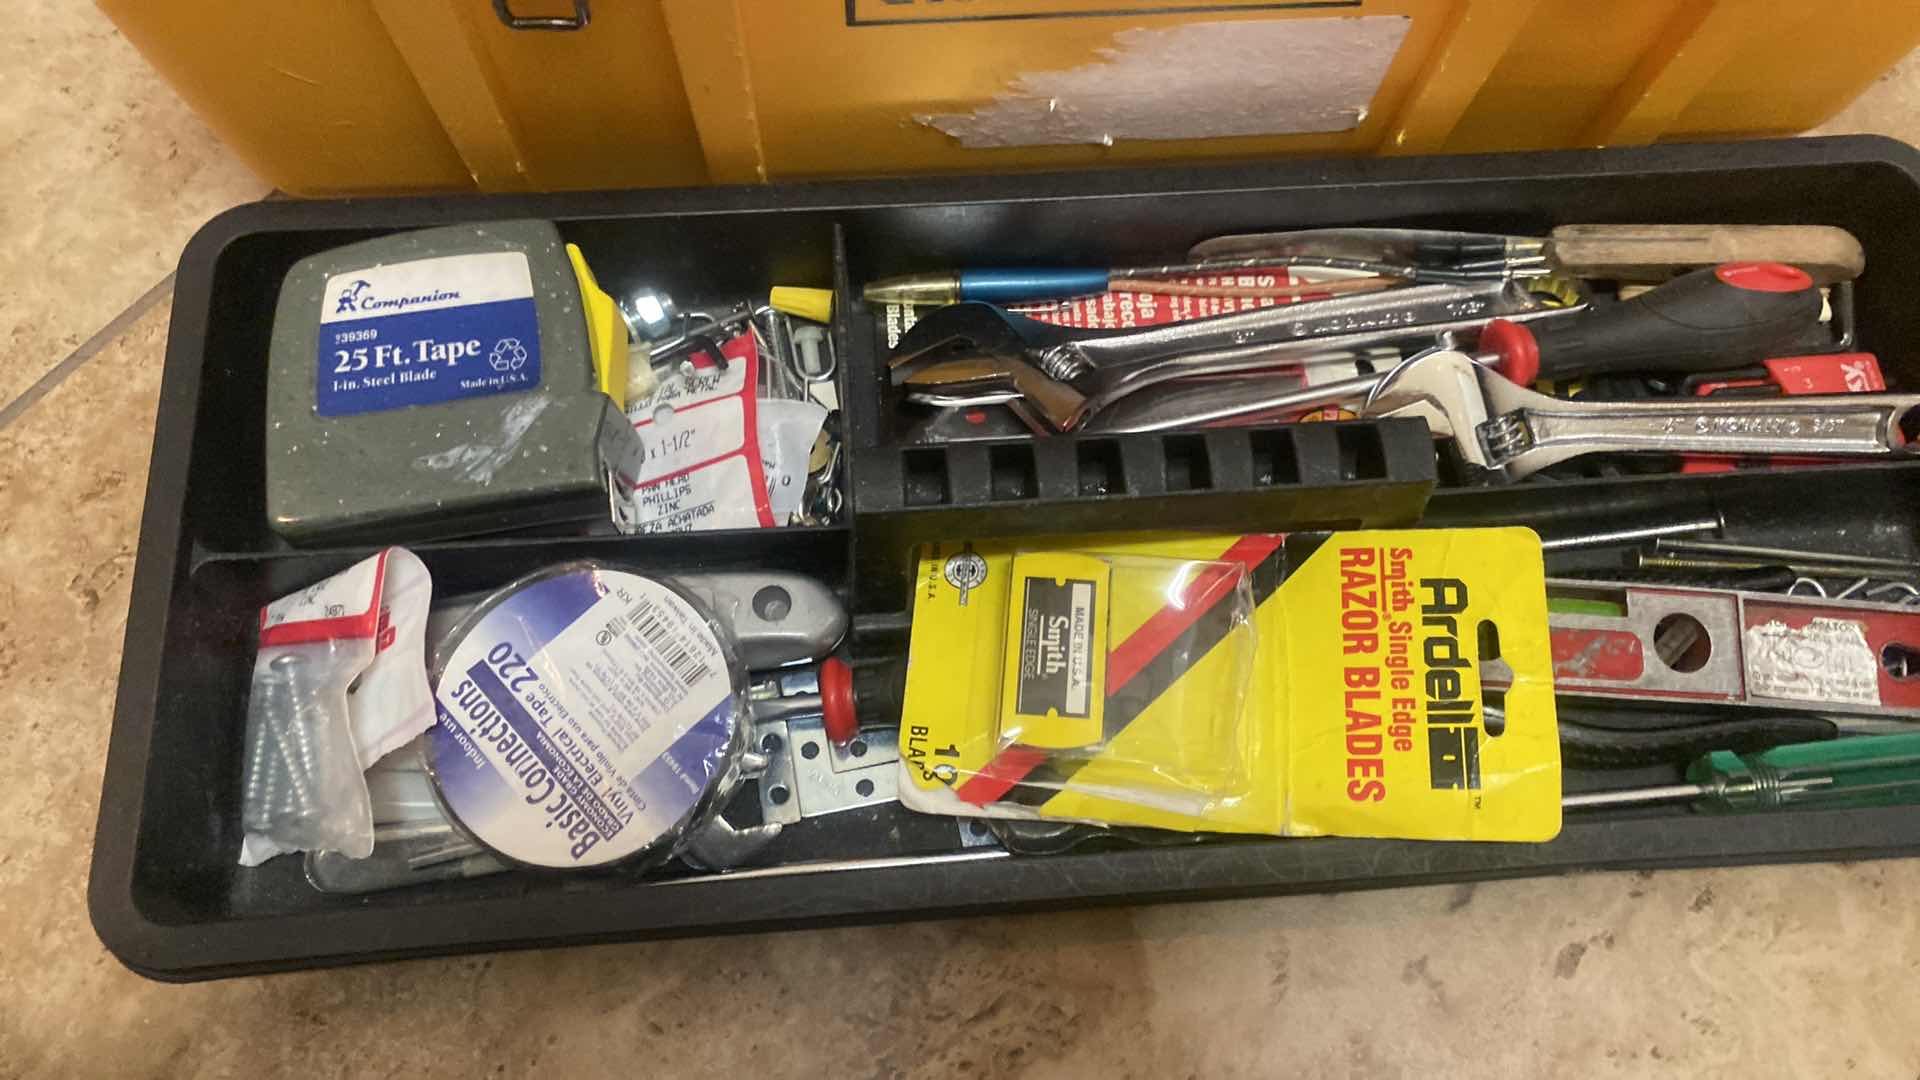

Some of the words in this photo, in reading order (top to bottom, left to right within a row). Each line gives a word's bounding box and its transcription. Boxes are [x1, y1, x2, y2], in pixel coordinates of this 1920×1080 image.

[360, 289, 460, 310] Companion
[886, 304, 901, 349] Blades
[334, 347, 369, 374] 25
[374, 343, 410, 368] Ft.
[412, 338, 481, 367] Tape
[333, 379, 360, 392] 1-in.
[363, 372, 395, 388] Steel
[400, 367, 437, 384] Blade
[460, 377, 487, 390] Made
[489, 376, 499, 386] in
[661, 427, 696, 456] 1-1/2"
[642, 484, 692, 508] PHILLIPS
[657, 500, 682, 516] ZINC
[615, 586, 633, 605] KR
[1389, 547, 1415, 612] Smith
[1339, 546, 1375, 656] RAZOR
[1025, 608, 1039, 647] SINGLE
[1073, 607, 1084, 639] MADE
[1044, 615, 1069, 675] Smith
[1072, 643, 1083, 653] IN
[1384, 622, 1415, 690] Single
[1419, 577, 1475, 725] Ardell
[483, 637, 540, 696] 220
[1023, 649, 1036, 681] EDGE
[1071, 656, 1083, 690] U.S.A.
[436, 712, 457, 734] use
[521, 689, 552, 728] Tape
[1387, 698, 1416, 752] Edge
[450, 677, 560, 809] Connections
[454, 728, 487, 770] Indoor
[579, 730, 599, 752] para
[1343, 666, 1386, 802] BLADES
[533, 730, 575, 776] ECONOMIA
[551, 726, 605, 785] Electrical
[551, 764, 579, 794] GRADE
[571, 774, 584, 788] LA
[580, 785, 595, 801] DE
[614, 774, 628, 788] de
[575, 793, 615, 837] ECONOMY
[590, 798, 621, 832] GRADO
[600, 783, 635, 824] Vinyl
[625, 785, 647, 810] Cinta
[544, 792, 602, 861] Basic
